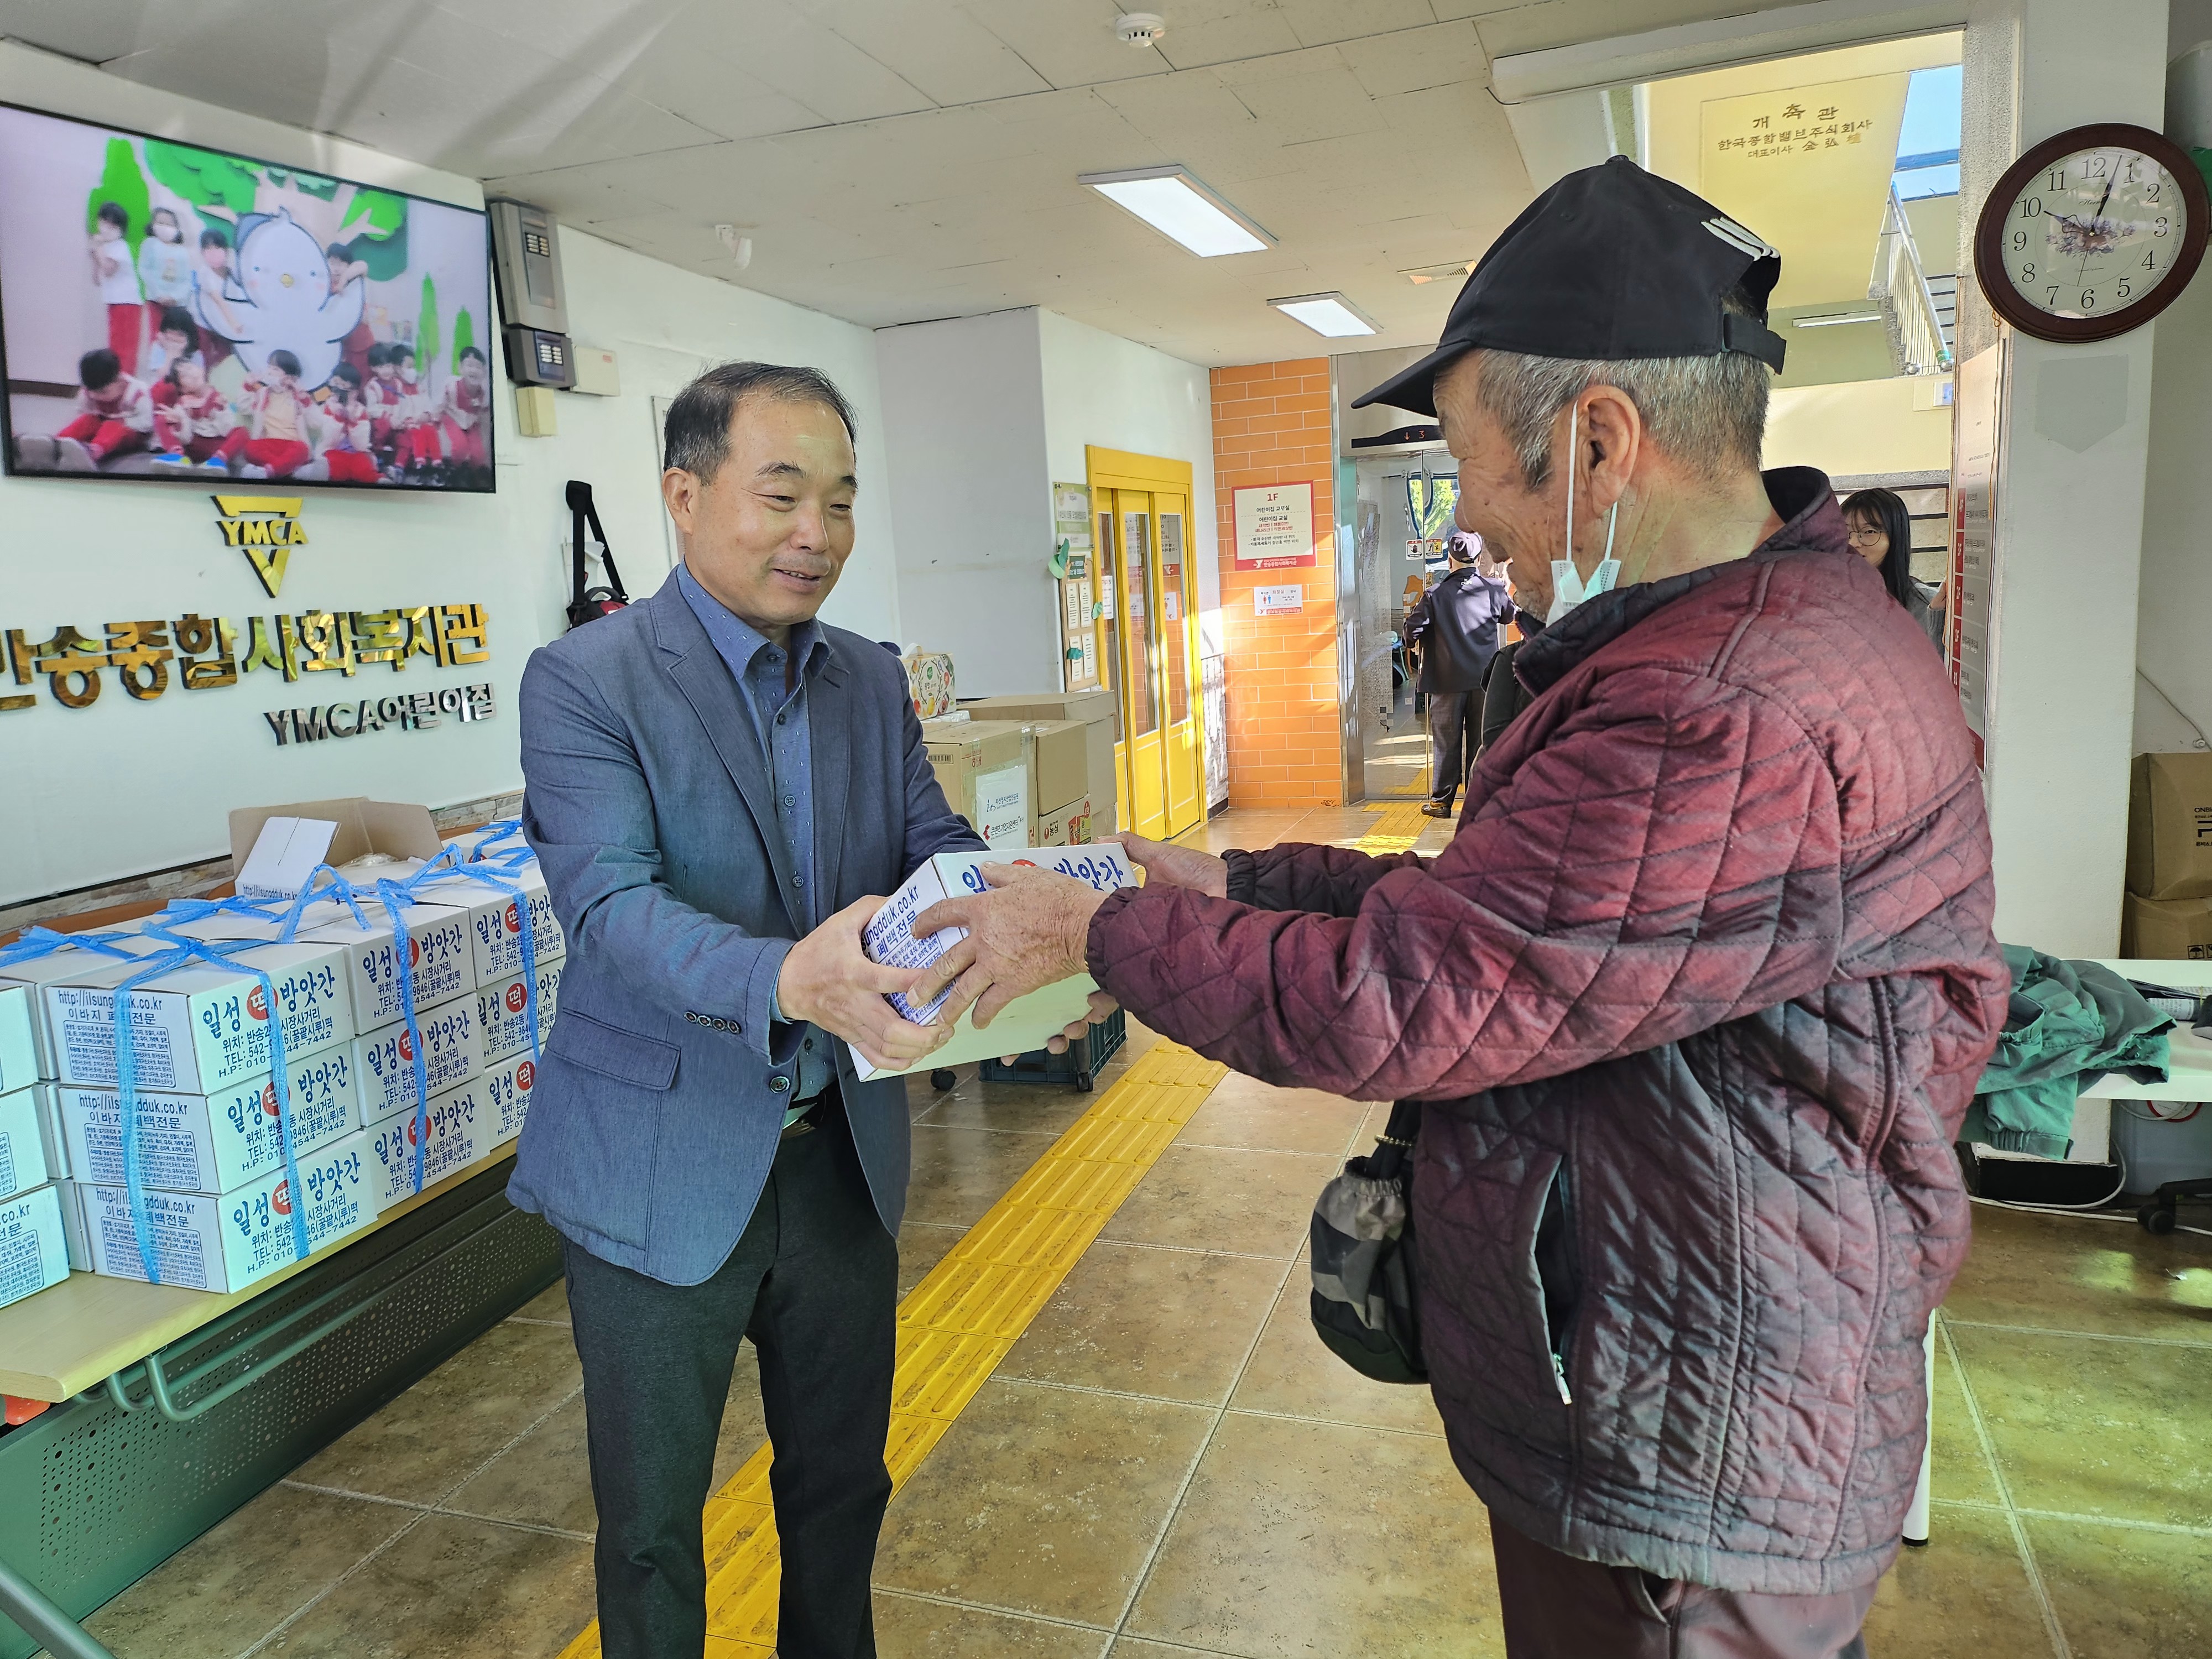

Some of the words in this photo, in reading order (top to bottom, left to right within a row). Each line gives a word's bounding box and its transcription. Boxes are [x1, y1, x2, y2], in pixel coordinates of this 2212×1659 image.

[1748, 145, 1793, 159] 대표이사
[2080, 157, 2106, 180] 12
[2124, 163, 2135, 184] 1
[2047, 170, 2067, 192] 11
[2146, 183, 2161, 204] 2
[2020, 197, 2042, 218] 10
[2153, 217, 2168, 237] 3
[2013, 231, 2027, 251] 9
[2141, 250, 2156, 270] 4
[2021, 263, 2036, 283] 8
[2046, 285, 2059, 305] 7
[2081, 289, 2095, 309] 6
[2117, 277, 2131, 298] 5
[1418, 430, 1425, 439] 3
[1267, 493, 1279, 502] 1F
[216, 520, 309, 546] YMCA
[263, 682, 498, 746] YMCA어린이집
[1050, 824, 1059, 836] 농심
[477, 910, 502, 945] 일성
[529, 894, 552, 927] 방앗
[490, 942, 504, 956] 위치:
[531, 924, 552, 941] 장사거리
[363, 946, 392, 983] 일성
[421, 924, 462, 964] 방앗간
[491, 956, 505, 967] TEL:
[378, 980, 394, 995] 위치:
[396, 972, 420, 990] 반동
[422, 960, 451, 980] 시장사거리
[58, 990, 162, 1011] http://ilsungk.co.kr
[203, 996, 241, 1039] 일성
[279, 965, 335, 1013] 방앗간
[379, 995, 395, 1008] TEL:
[395, 983, 460, 1011] 01-4544-7442
[508, 986, 521, 1009] 떡
[69, 1008, 101, 1021] 이바지
[107, 1011, 156, 1025] 전문
[488, 1023, 502, 1037] 위치:
[503, 1014, 525, 1031] 반송2동
[223, 1035, 244, 1052] 위치:
[247, 1024, 272, 1045] 반송2
[281, 1006, 320, 1031] 시장사거리
[246, 1031, 332, 1068] 010-44-7442
[368, 1037, 397, 1077] 일성
[427, 1010, 470, 1052] 방앗간
[489, 1035, 503, 1048] TEL:
[225, 1051, 246, 1066] TEL:
[383, 1072, 399, 1088] 위치:
[427, 1047, 459, 1069] 시장사거리
[228, 1090, 263, 1133] 일성
[298, 1055, 348, 1103] 방앗간
[384, 1086, 401, 1100] TEL:
[400, 1068, 468, 1102] 010544-7442
[489, 1071, 513, 1106] 일성
[518, 1064, 531, 1086] 떡
[79, 1094, 188, 1115] http://ilsdduk.co.kr
[501, 1102, 514, 1116] 위치:
[516, 1092, 532, 1109] 반송2
[246, 1129, 265, 1146] 위치:
[268, 1114, 296, 1137] 반송동
[299, 1096, 335, 1122] 시장사거리
[502, 1113, 515, 1126] TEL:
[517, 1107, 527, 1119] 542
[515, 1118, 525, 1128] 01
[267, 1120, 345, 1160] 0104544-7442
[374, 1125, 403, 1165] 일성
[433, 1094, 475, 1137] 방앗간
[248, 1142, 267, 1160] TEL:
[389, 1160, 405, 1177] 위치:
[407, 1147, 431, 1167] 반동
[433, 1130, 463, 1155] 시장사거리
[390, 1174, 407, 1188] TEL:
[406, 1151, 472, 1189] 01-4544-7442
[96, 1187, 195, 1214] http://ilgdduk.co.kr
[233, 1192, 269, 1236] 일성
[307, 1152, 361, 1202] 방앗간
[252, 1229, 272, 1249] 위치:
[307, 1193, 346, 1222] 시장사거리
[253, 1244, 274, 1262] TEL:
[276, 1201, 358, 1250] 542-46(꿀팥시루)떡
[274, 1216, 357, 1261] 010-544-7442
